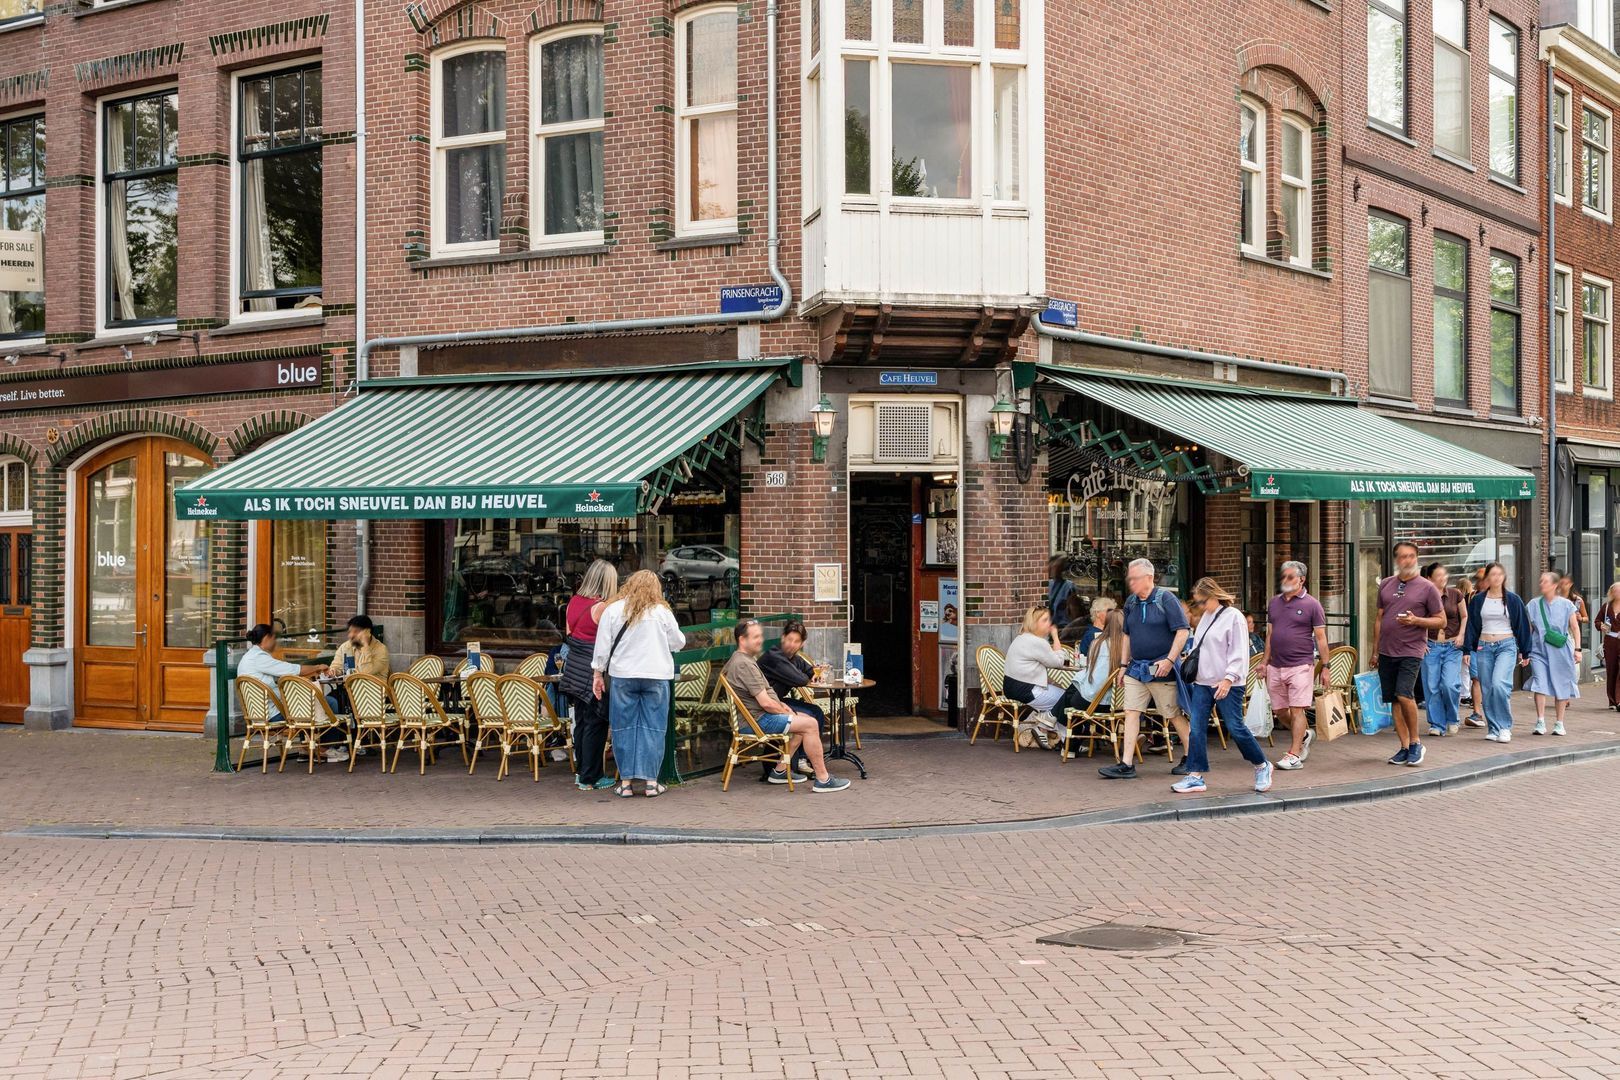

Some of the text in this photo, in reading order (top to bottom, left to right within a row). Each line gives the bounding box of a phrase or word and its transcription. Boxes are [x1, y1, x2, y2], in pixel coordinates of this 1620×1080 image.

[0, 242, 35, 252] FOR SALE
[722, 286, 779, 300] PRINSENGRACHT
[278, 362, 317, 384] blue
[880, 373, 936, 383] CAFE HEUVEL
[20, 389, 37, 400] Live
[38, 388, 65, 399] better.
[766, 472, 785, 486] 568
[1350, 480, 1475, 493] ALS IK TOCH SNEUVEL DAN BIJ HEUVEL
[244, 494, 547, 512] ALS IK TOCH SNEUVEL DAN BIJ HEUVEL
[575, 502, 615, 512] Heineken
[187, 507, 218, 516] Heineken
[97, 550, 126, 567] blue
[818, 569, 836, 578] NO
